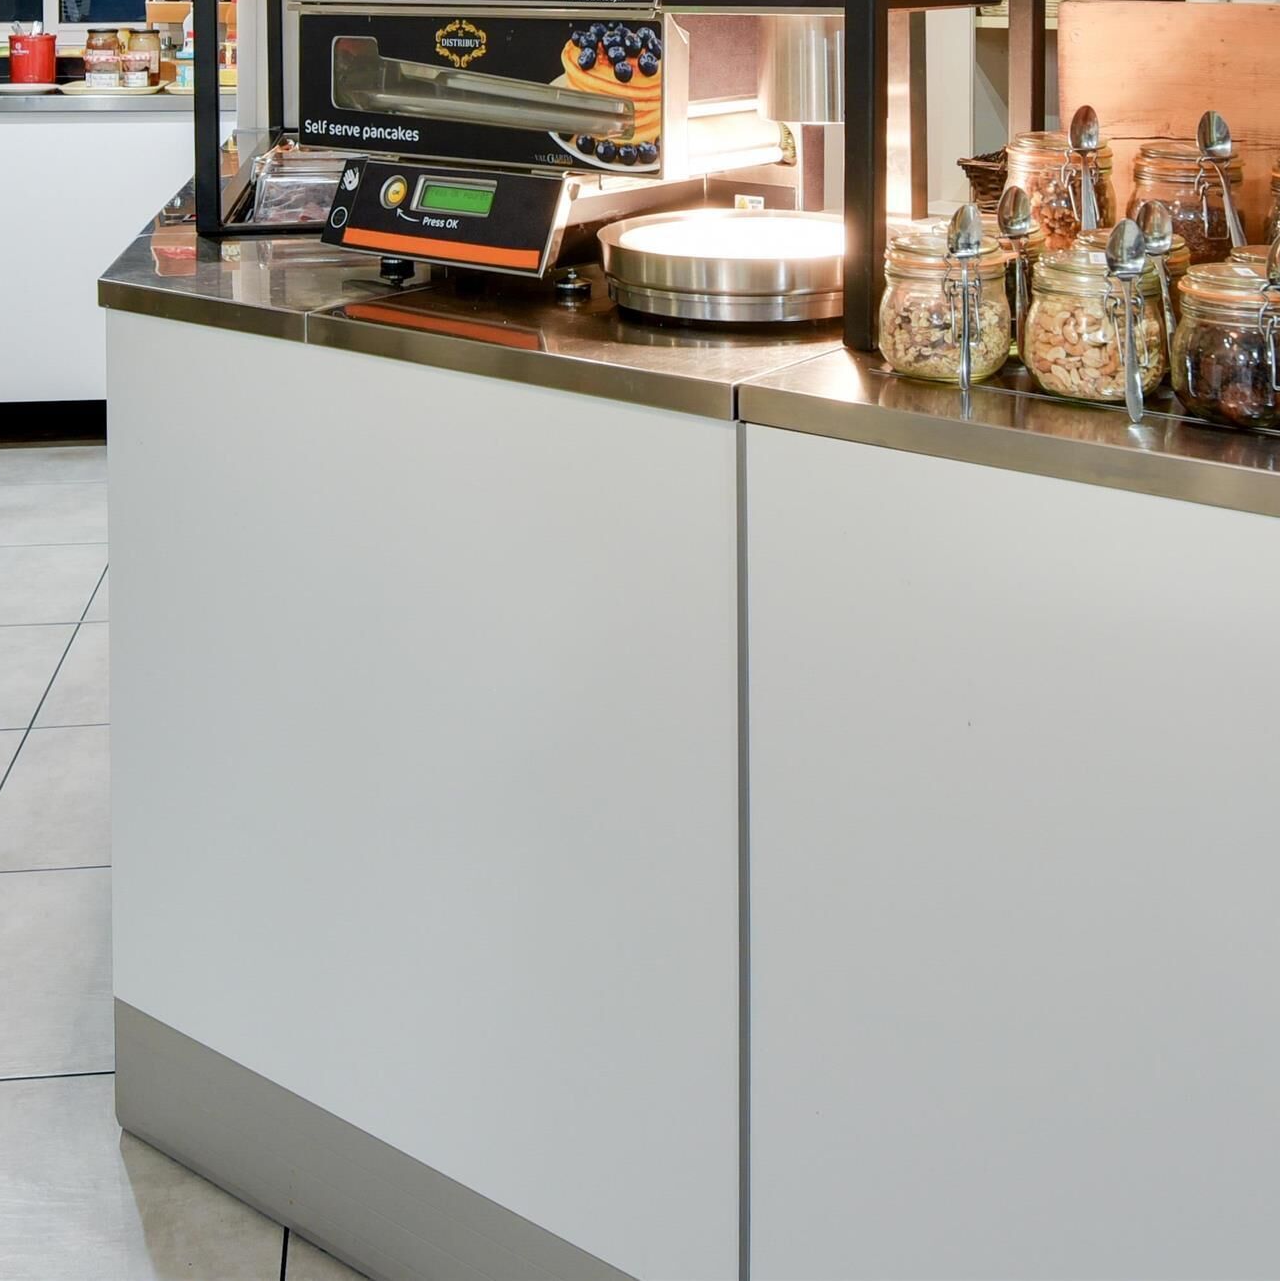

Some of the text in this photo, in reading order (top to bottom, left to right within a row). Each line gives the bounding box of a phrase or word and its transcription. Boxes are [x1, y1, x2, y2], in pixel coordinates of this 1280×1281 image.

[441, 38, 480, 48] DISTRIBUY
[304, 119, 420, 142] Self serve pancakes
[422, 216, 460, 229] Press OK
